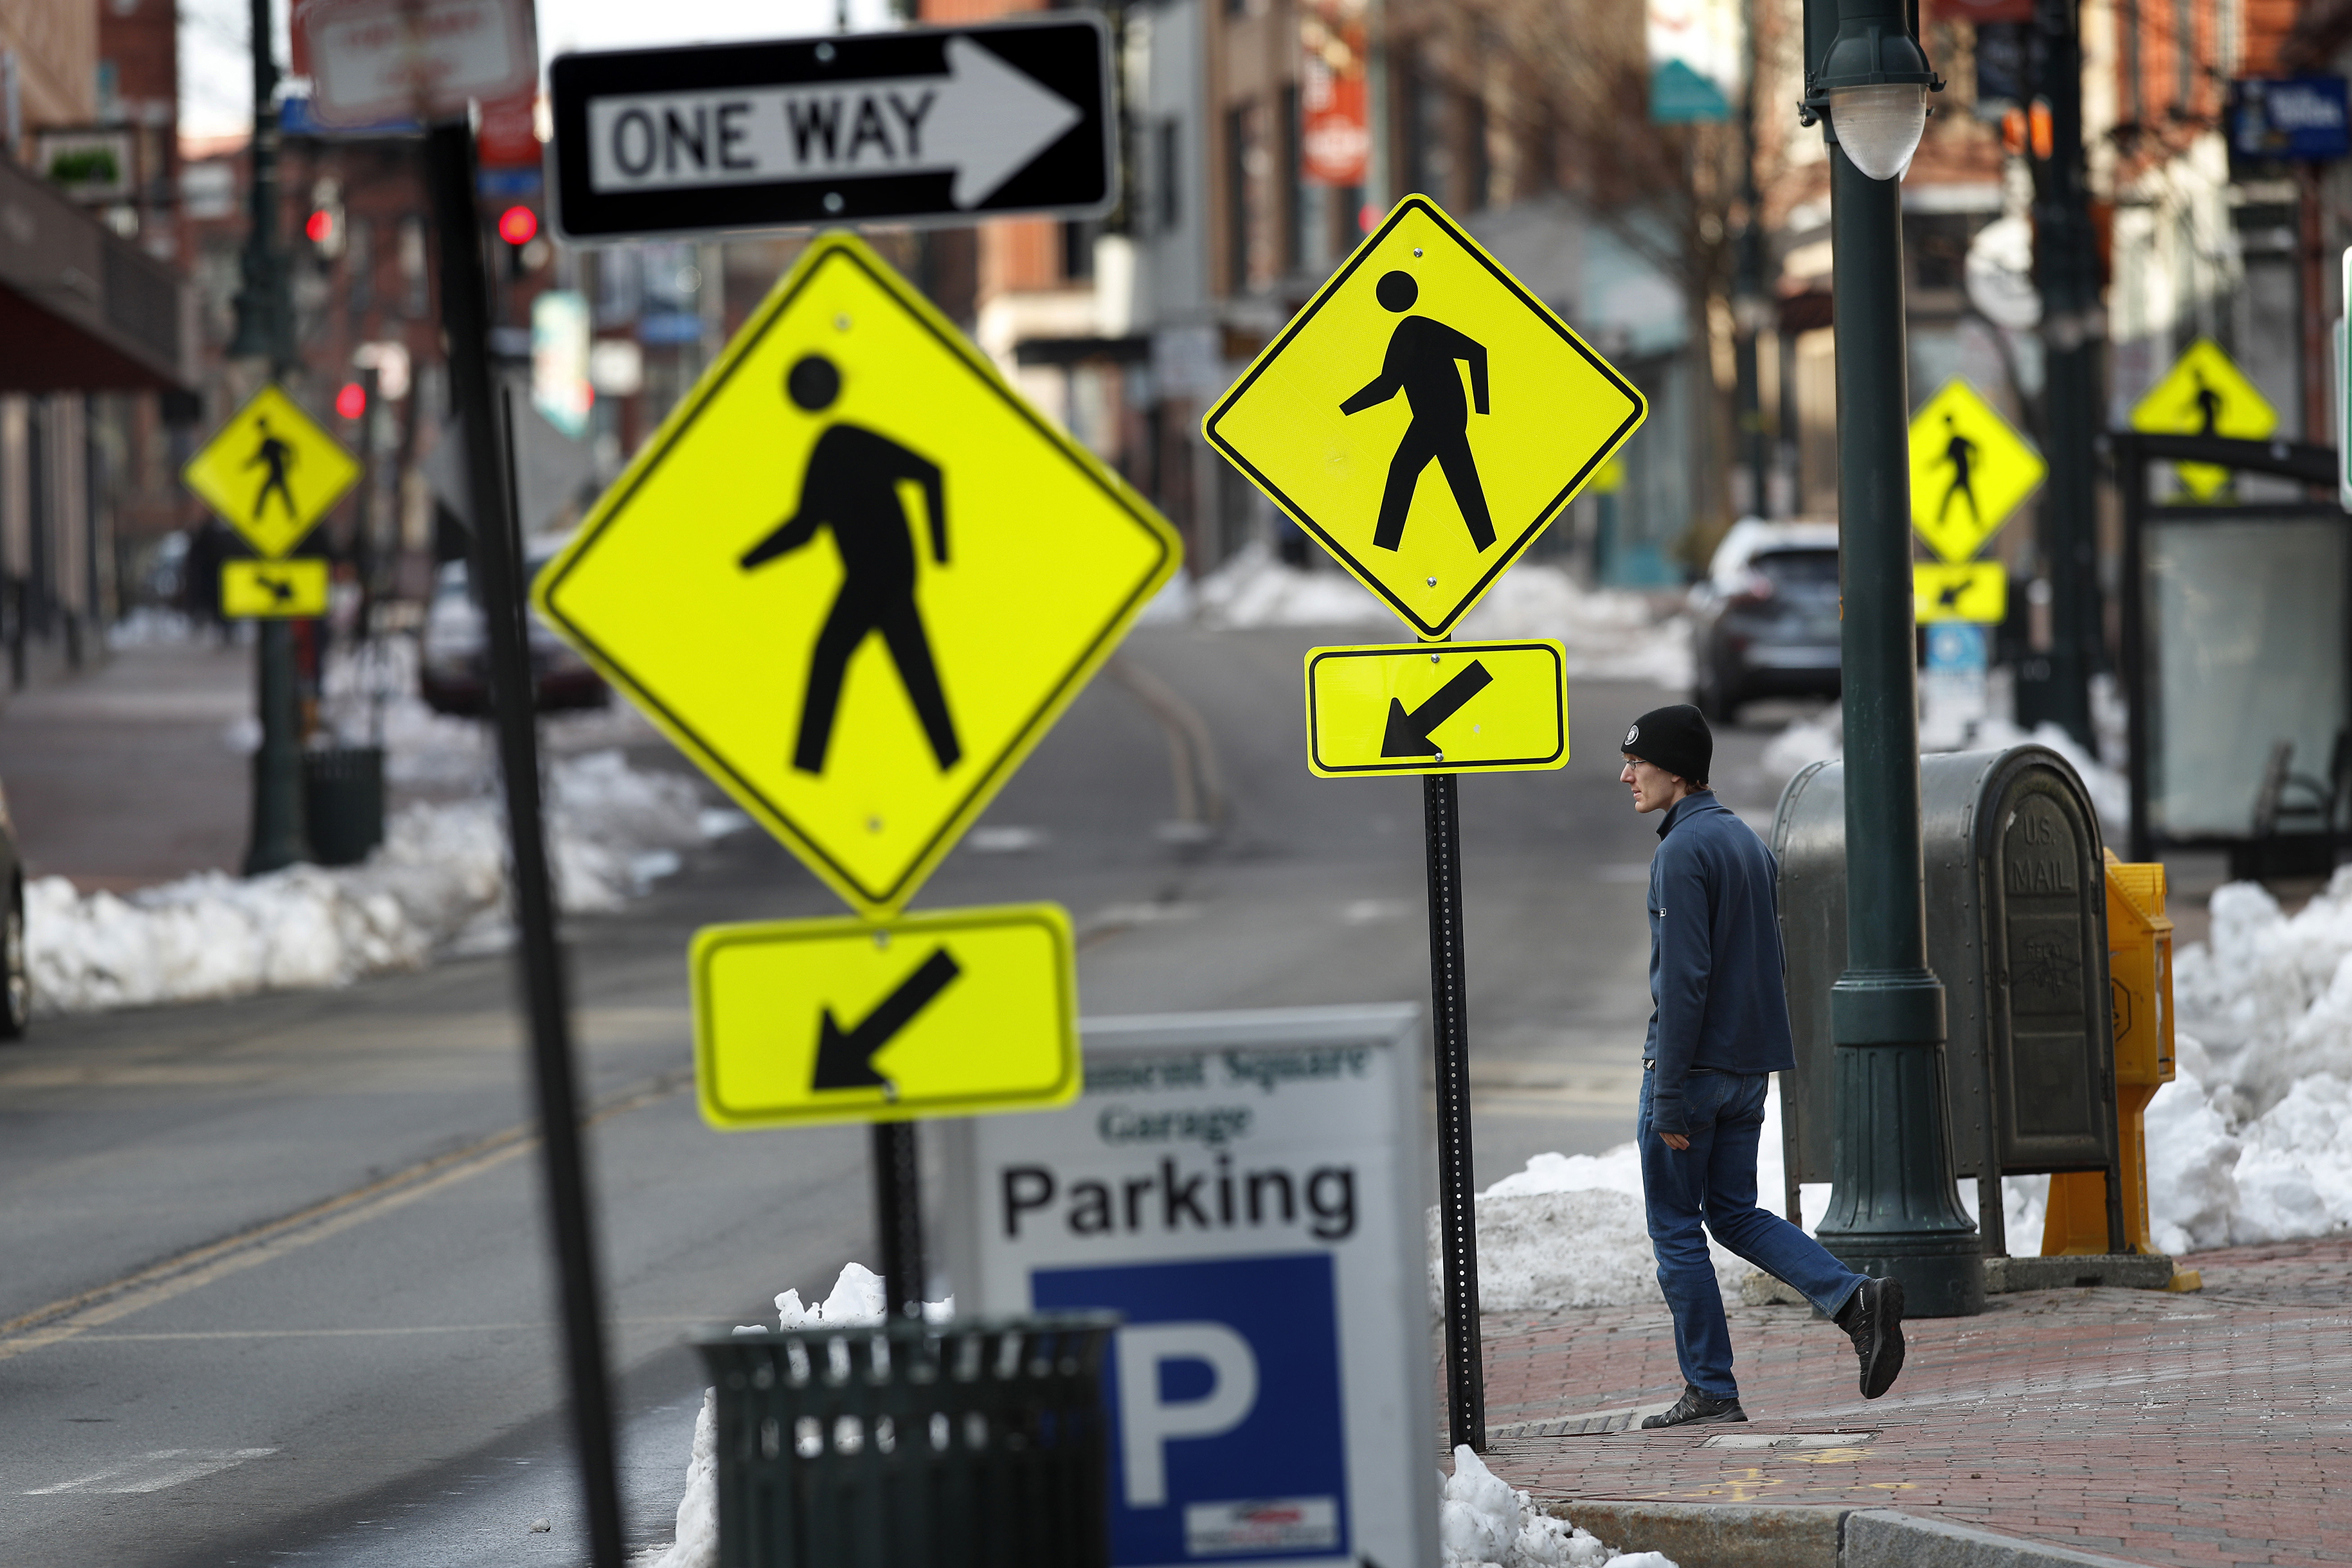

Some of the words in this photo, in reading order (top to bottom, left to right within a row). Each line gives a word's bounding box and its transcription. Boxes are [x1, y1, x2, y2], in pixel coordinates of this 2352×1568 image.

[611, 103, 757, 178] ONE
[785, 91, 937, 166] WAY
[2024, 814, 2056, 844] U.S.
[2013, 860, 2070, 891] MAIL
[1223, 1044, 1370, 1094] Square
[1097, 1103, 1252, 1147] Garage
[1001, 1156, 1358, 1240] Parking
[1117, 1321, 1258, 1508] P
